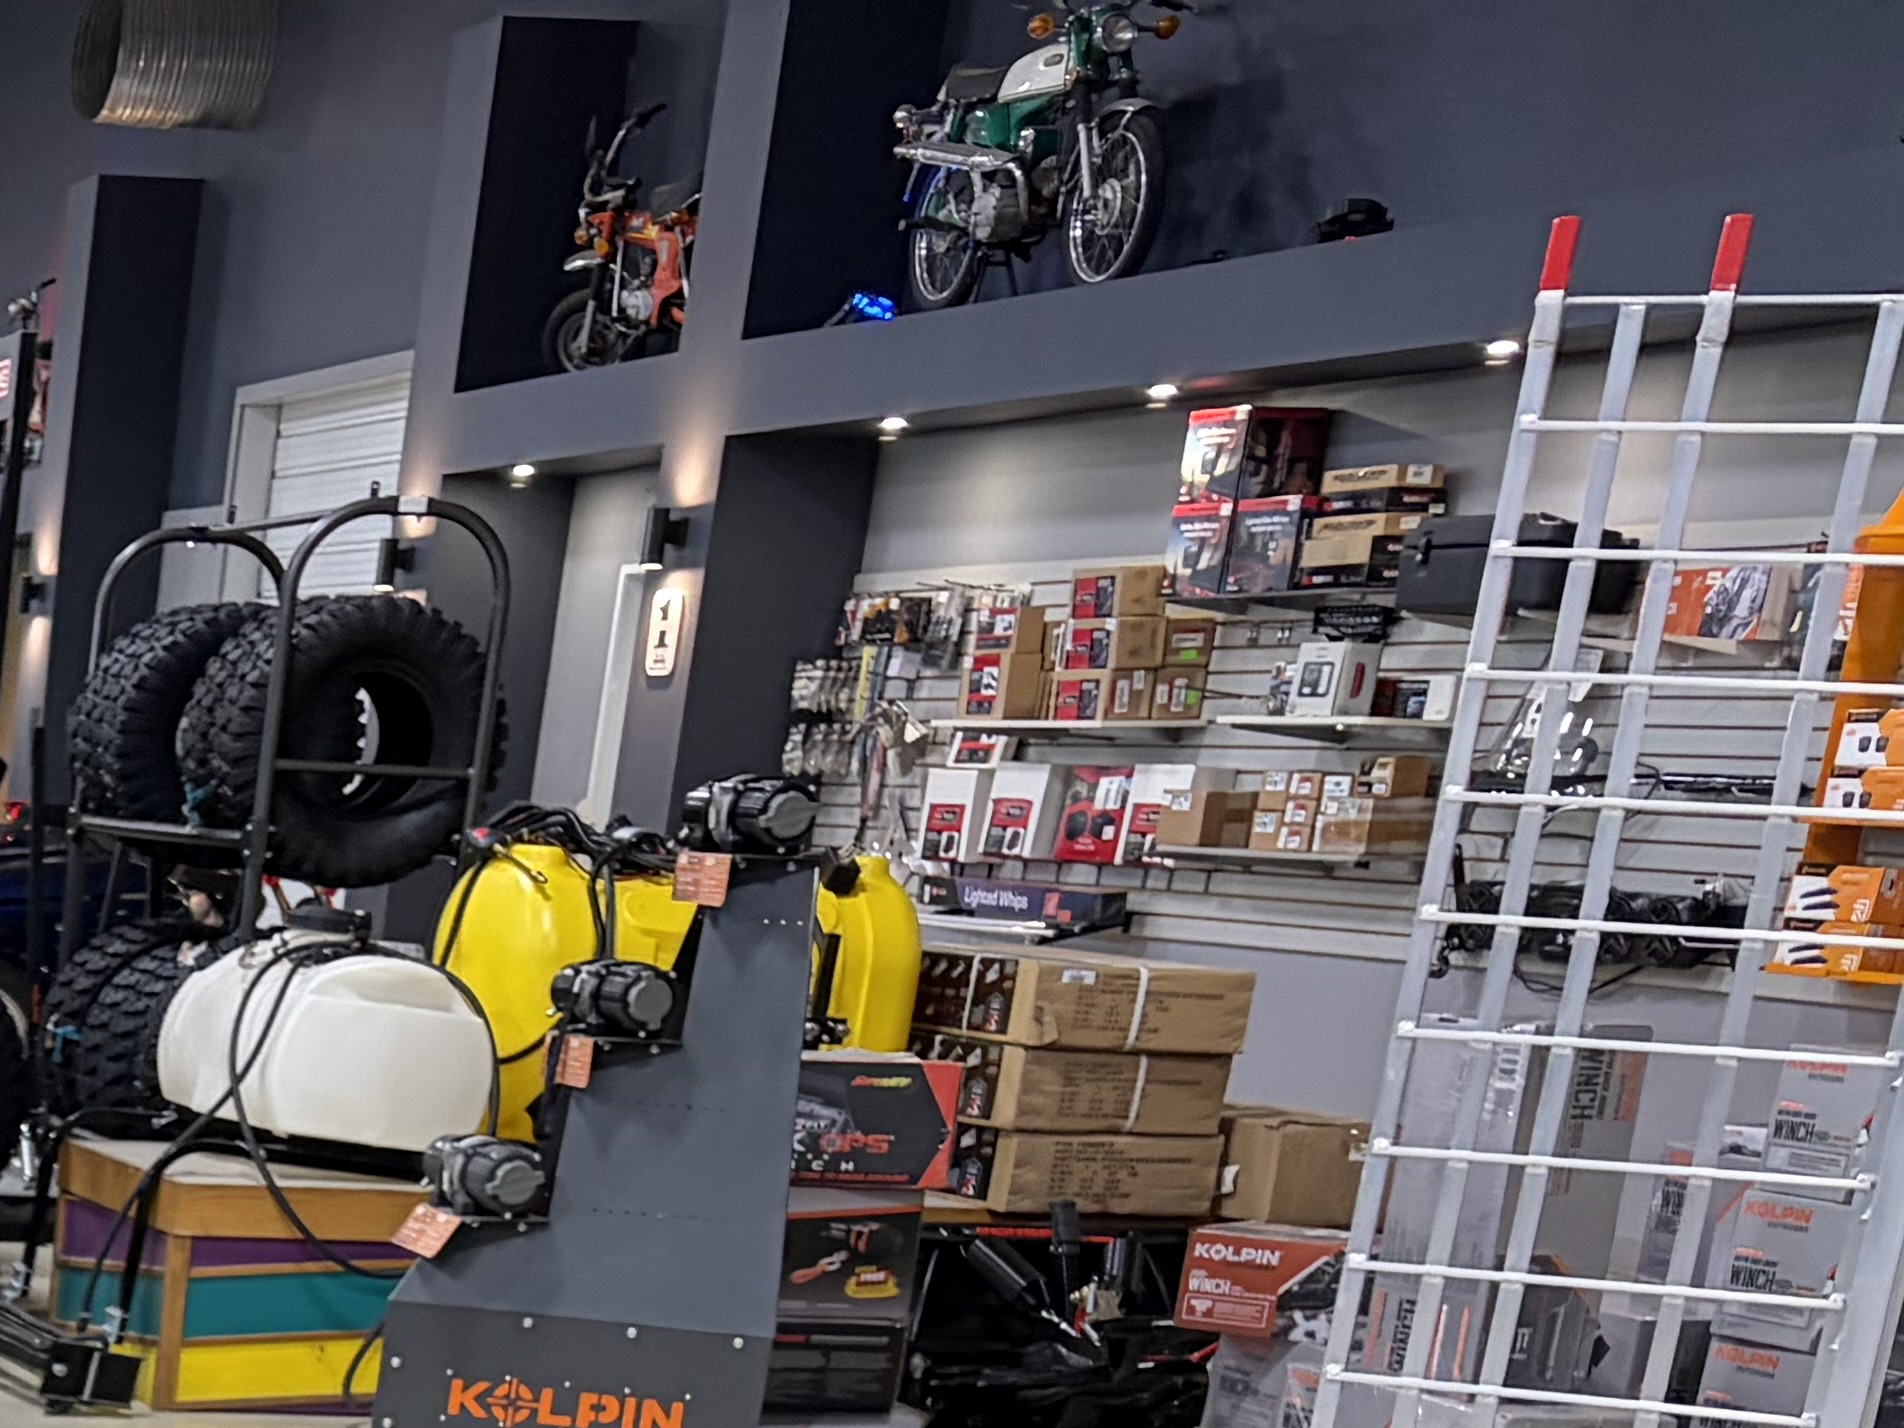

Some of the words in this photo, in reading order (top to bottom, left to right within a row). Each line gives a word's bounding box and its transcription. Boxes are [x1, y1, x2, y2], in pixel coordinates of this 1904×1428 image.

[964, 886, 1000, 908] Lighted
[1001, 888, 1028, 911] Whips
[1773, 1117, 1817, 1145] WINCH
[1744, 1201, 1814, 1225] KOLPIN
[1193, 1241, 1282, 1267] KOLPIN
[1188, 1272, 1231, 1296] WINCH
[1730, 1263, 1777, 1292] WINCH
